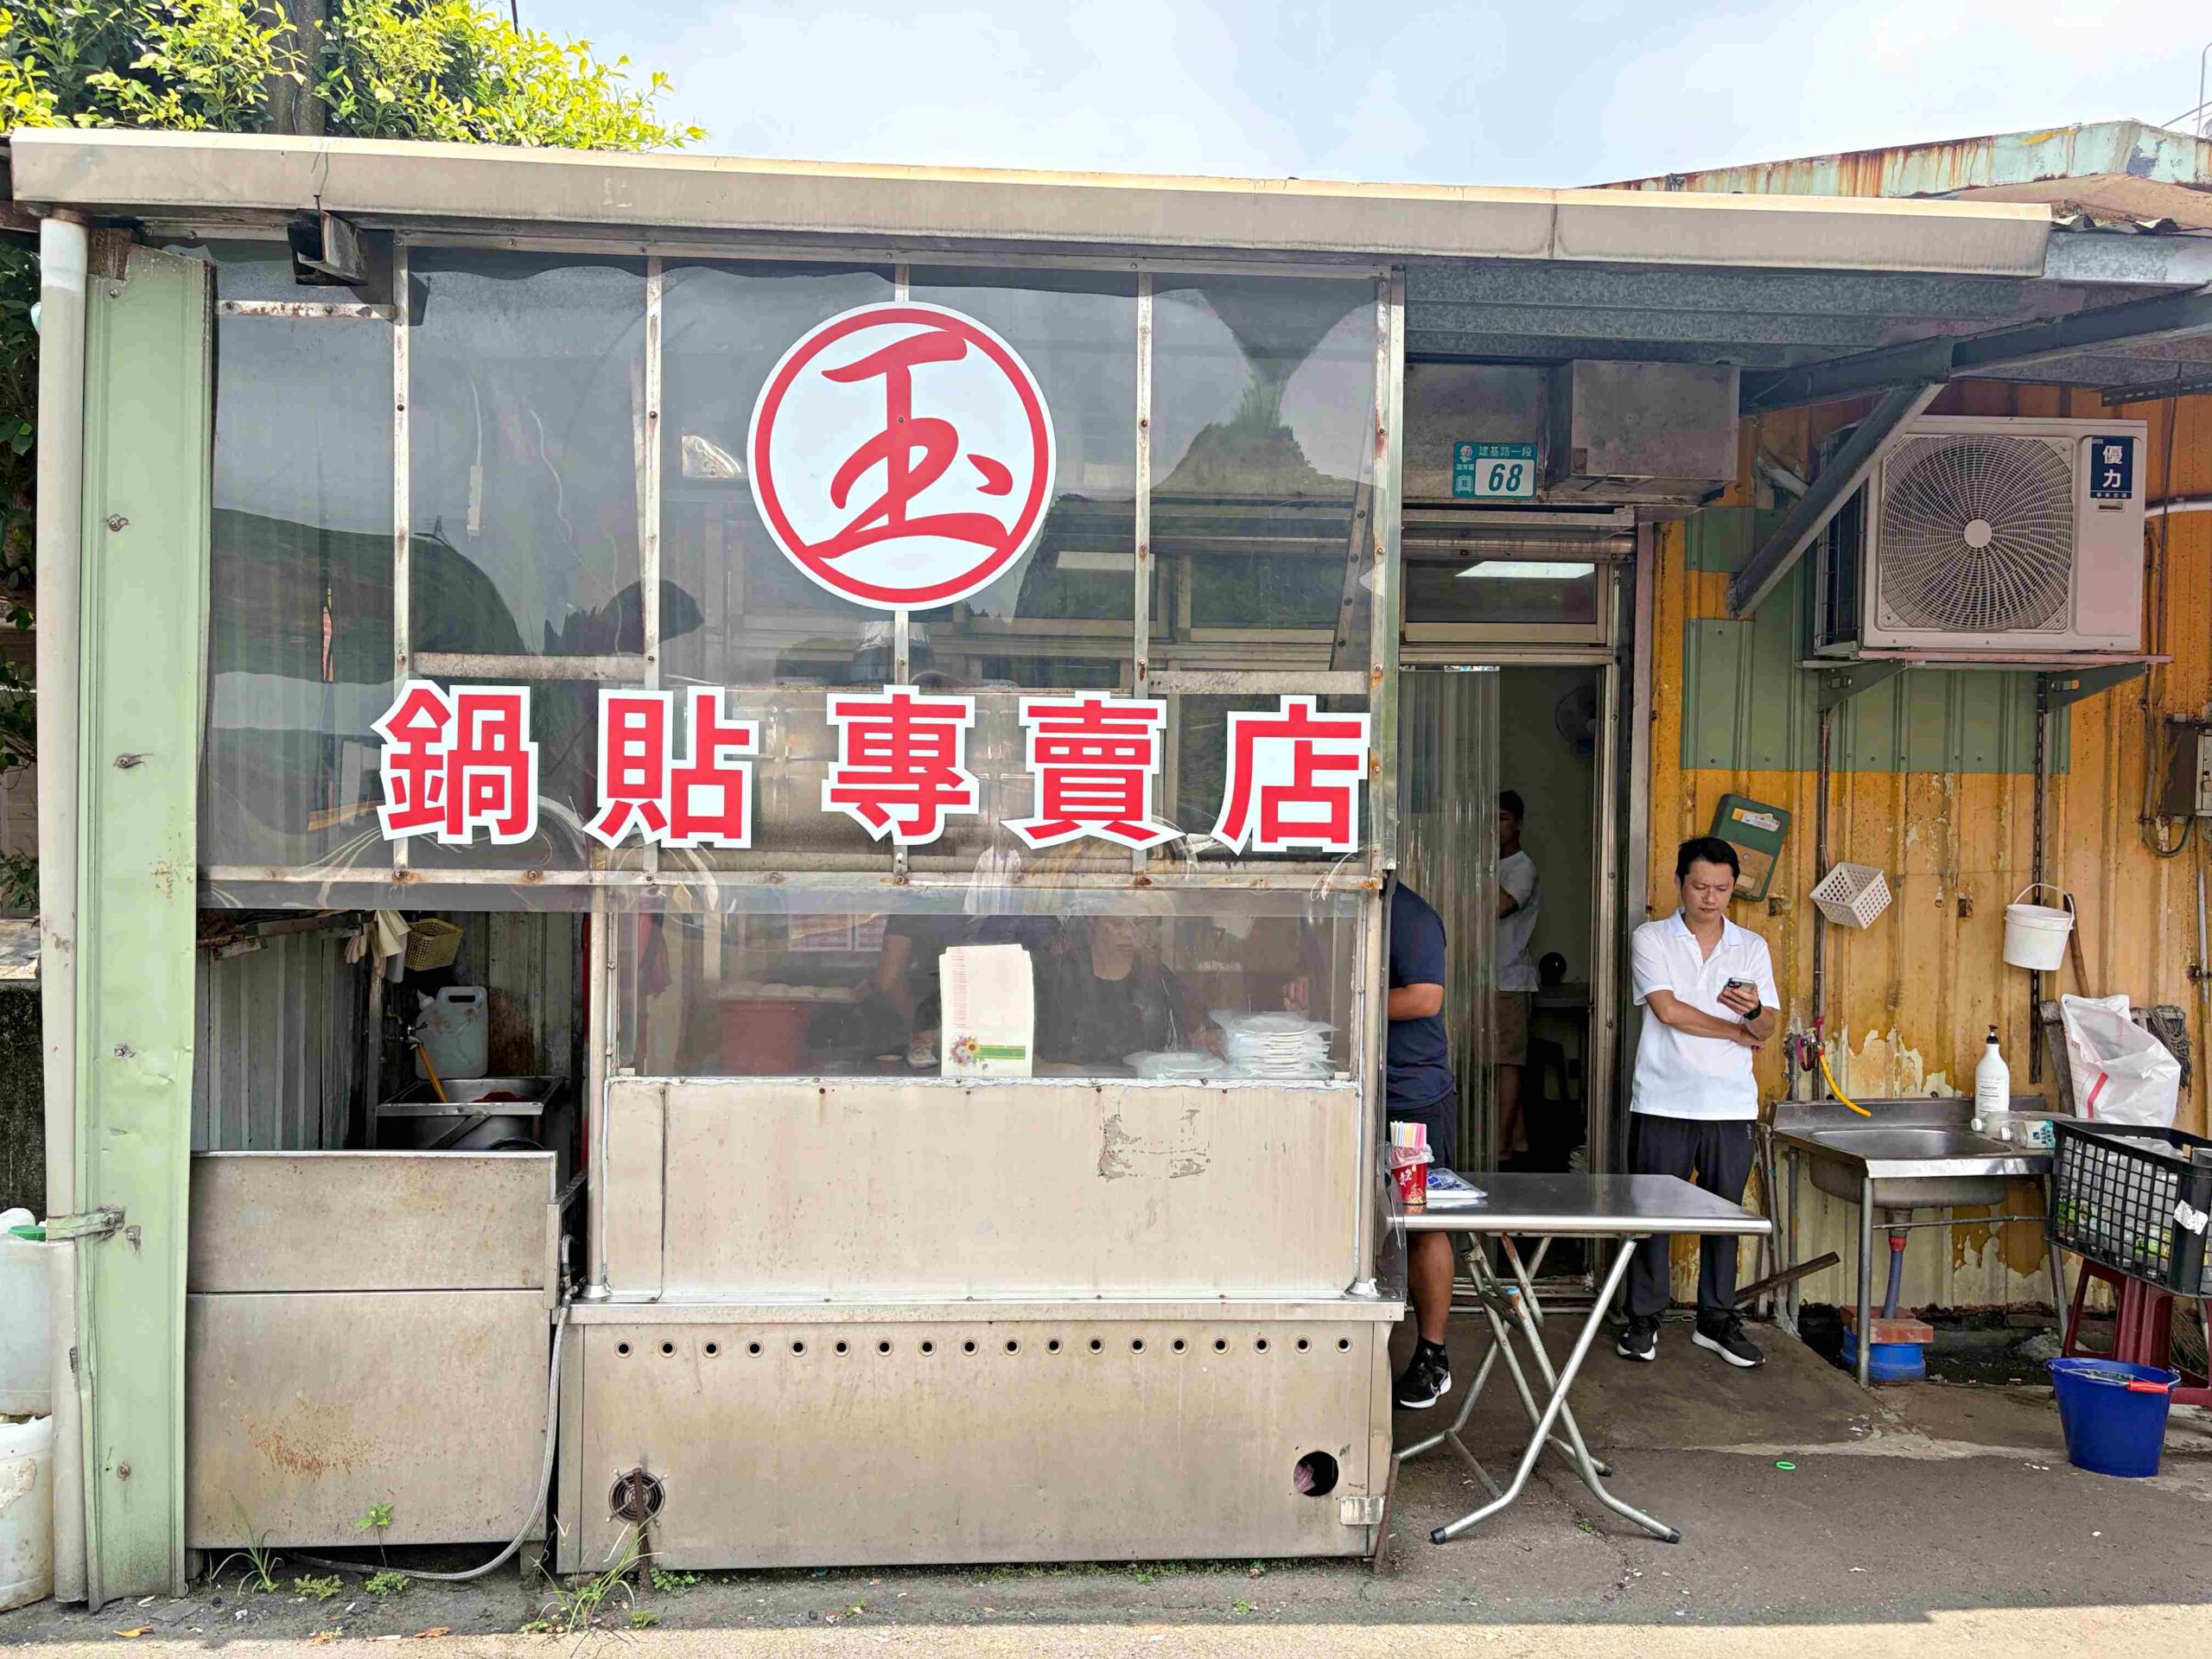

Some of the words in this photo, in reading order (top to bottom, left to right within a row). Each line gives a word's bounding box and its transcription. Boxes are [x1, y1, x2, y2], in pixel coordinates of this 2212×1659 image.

[1478, 446, 1533, 457] 建基路一段
[2102, 445, 2123, 488] 優力
[1488, 463, 1523, 492] 68
[375, 682, 1369, 854] 鍋貼專賣店
